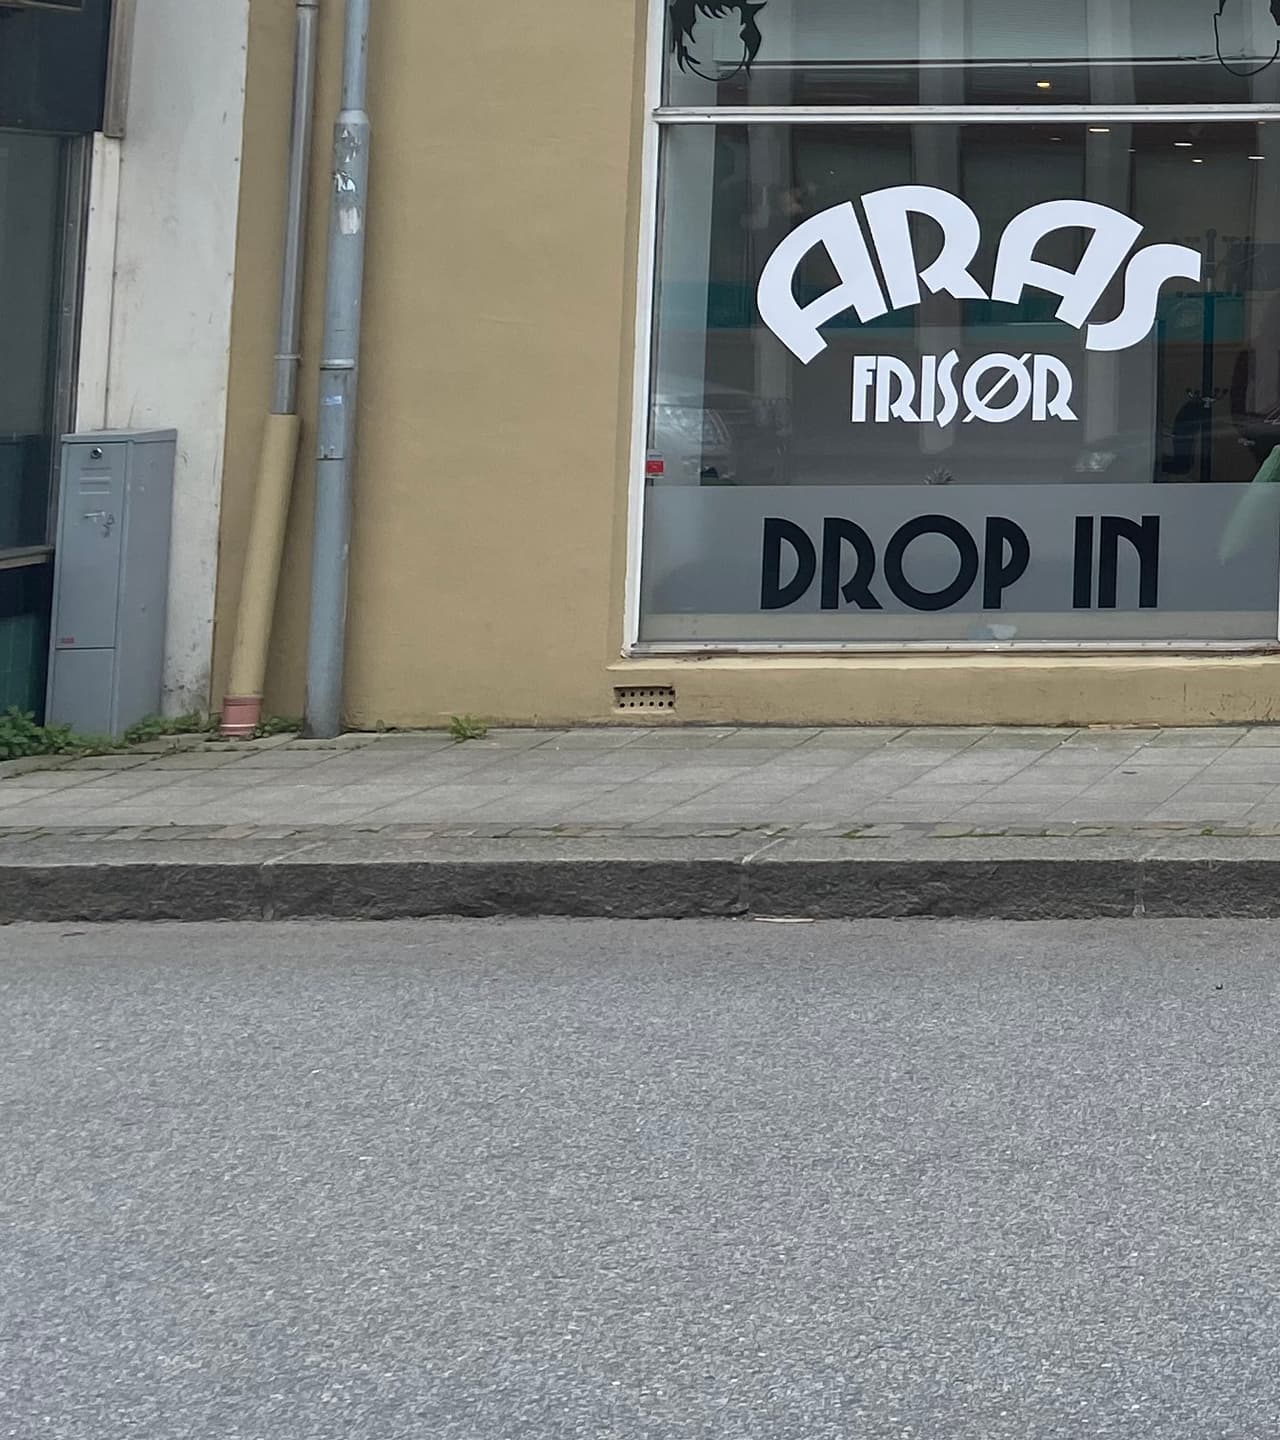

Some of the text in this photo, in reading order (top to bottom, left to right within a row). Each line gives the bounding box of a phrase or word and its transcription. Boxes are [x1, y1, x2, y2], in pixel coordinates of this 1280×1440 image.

[757, 185, 1202, 365] ARAS
[851, 349, 1078, 427] FRISØR
[760, 514, 1161, 611] DROP IN
